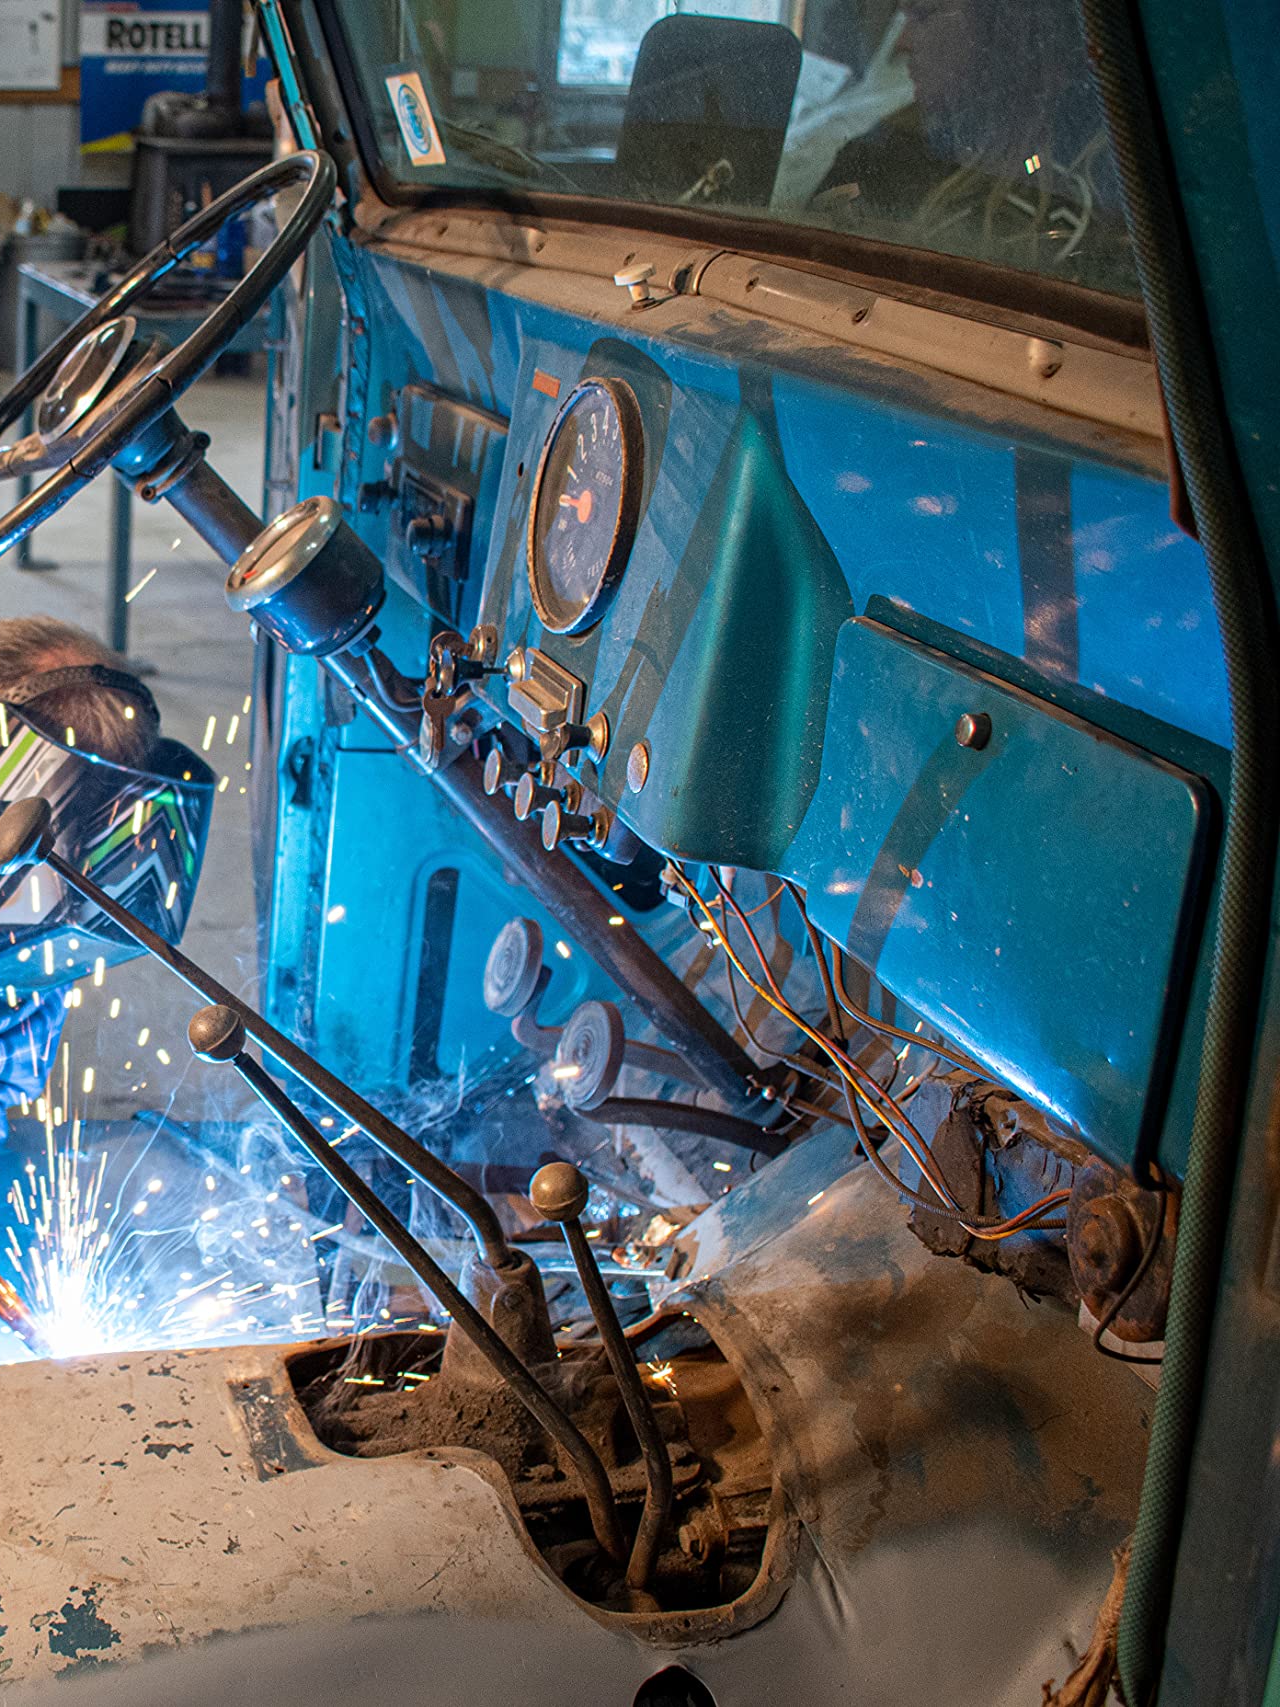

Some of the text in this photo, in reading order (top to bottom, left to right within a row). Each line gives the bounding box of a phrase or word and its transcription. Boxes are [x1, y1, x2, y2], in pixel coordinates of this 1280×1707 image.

[106, 19, 208, 50] ROTELL
[578, 433, 587, 461] 2
[590, 413, 598, 443] 3
[602, 405, 610, 436] 4
